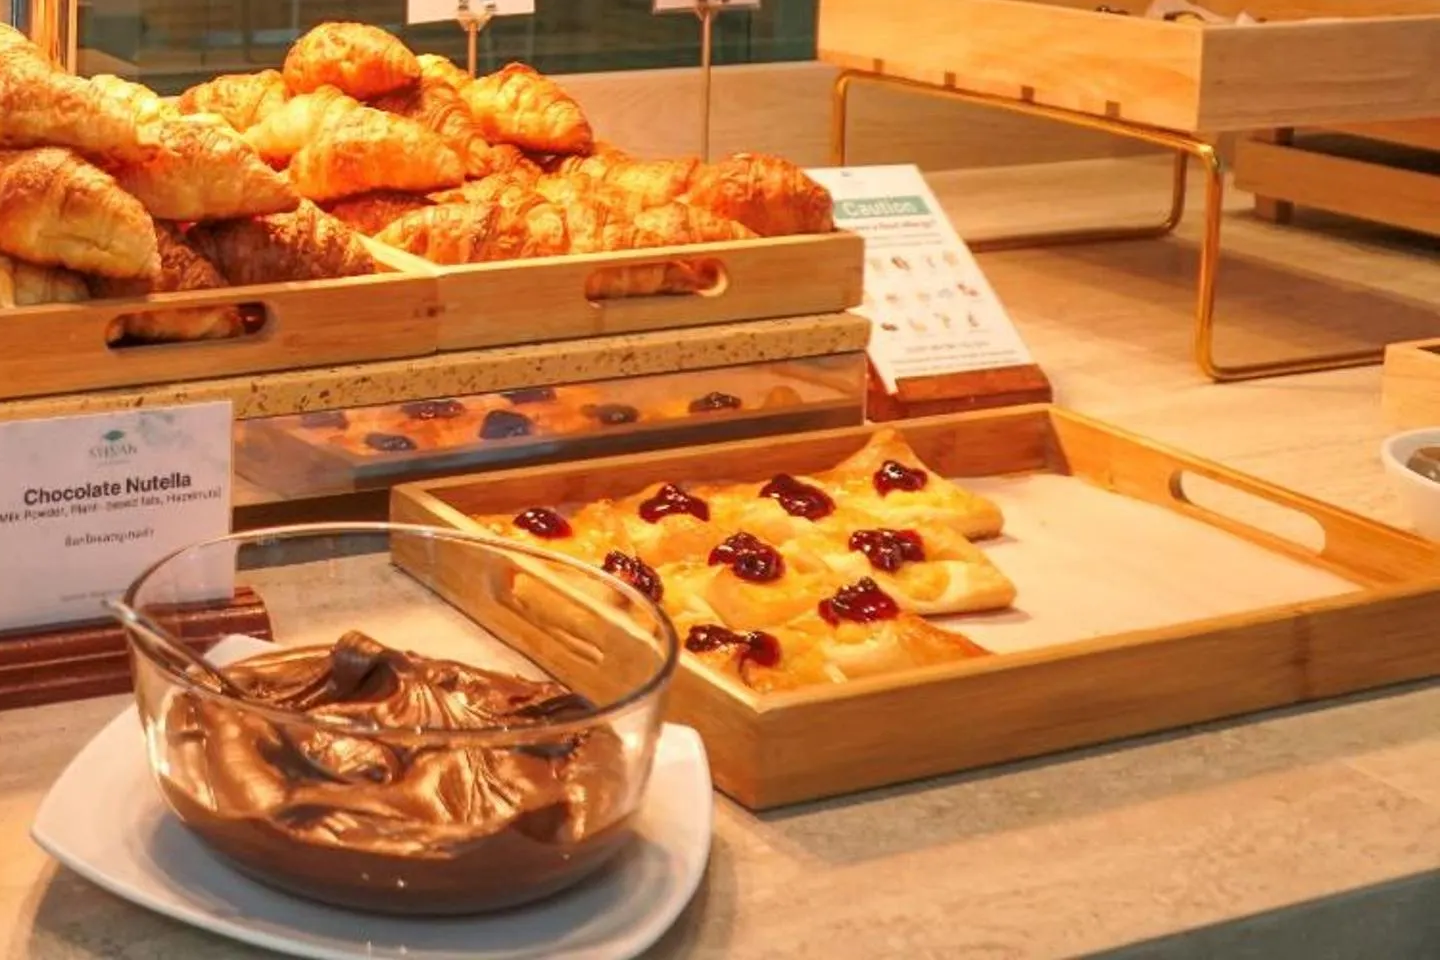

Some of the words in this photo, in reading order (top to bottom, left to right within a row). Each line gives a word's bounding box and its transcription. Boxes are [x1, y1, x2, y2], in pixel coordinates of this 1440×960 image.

[842, 198, 918, 217] Caution
[23, 481, 122, 506] Chocolate
[126, 471, 192, 494] Nutella
